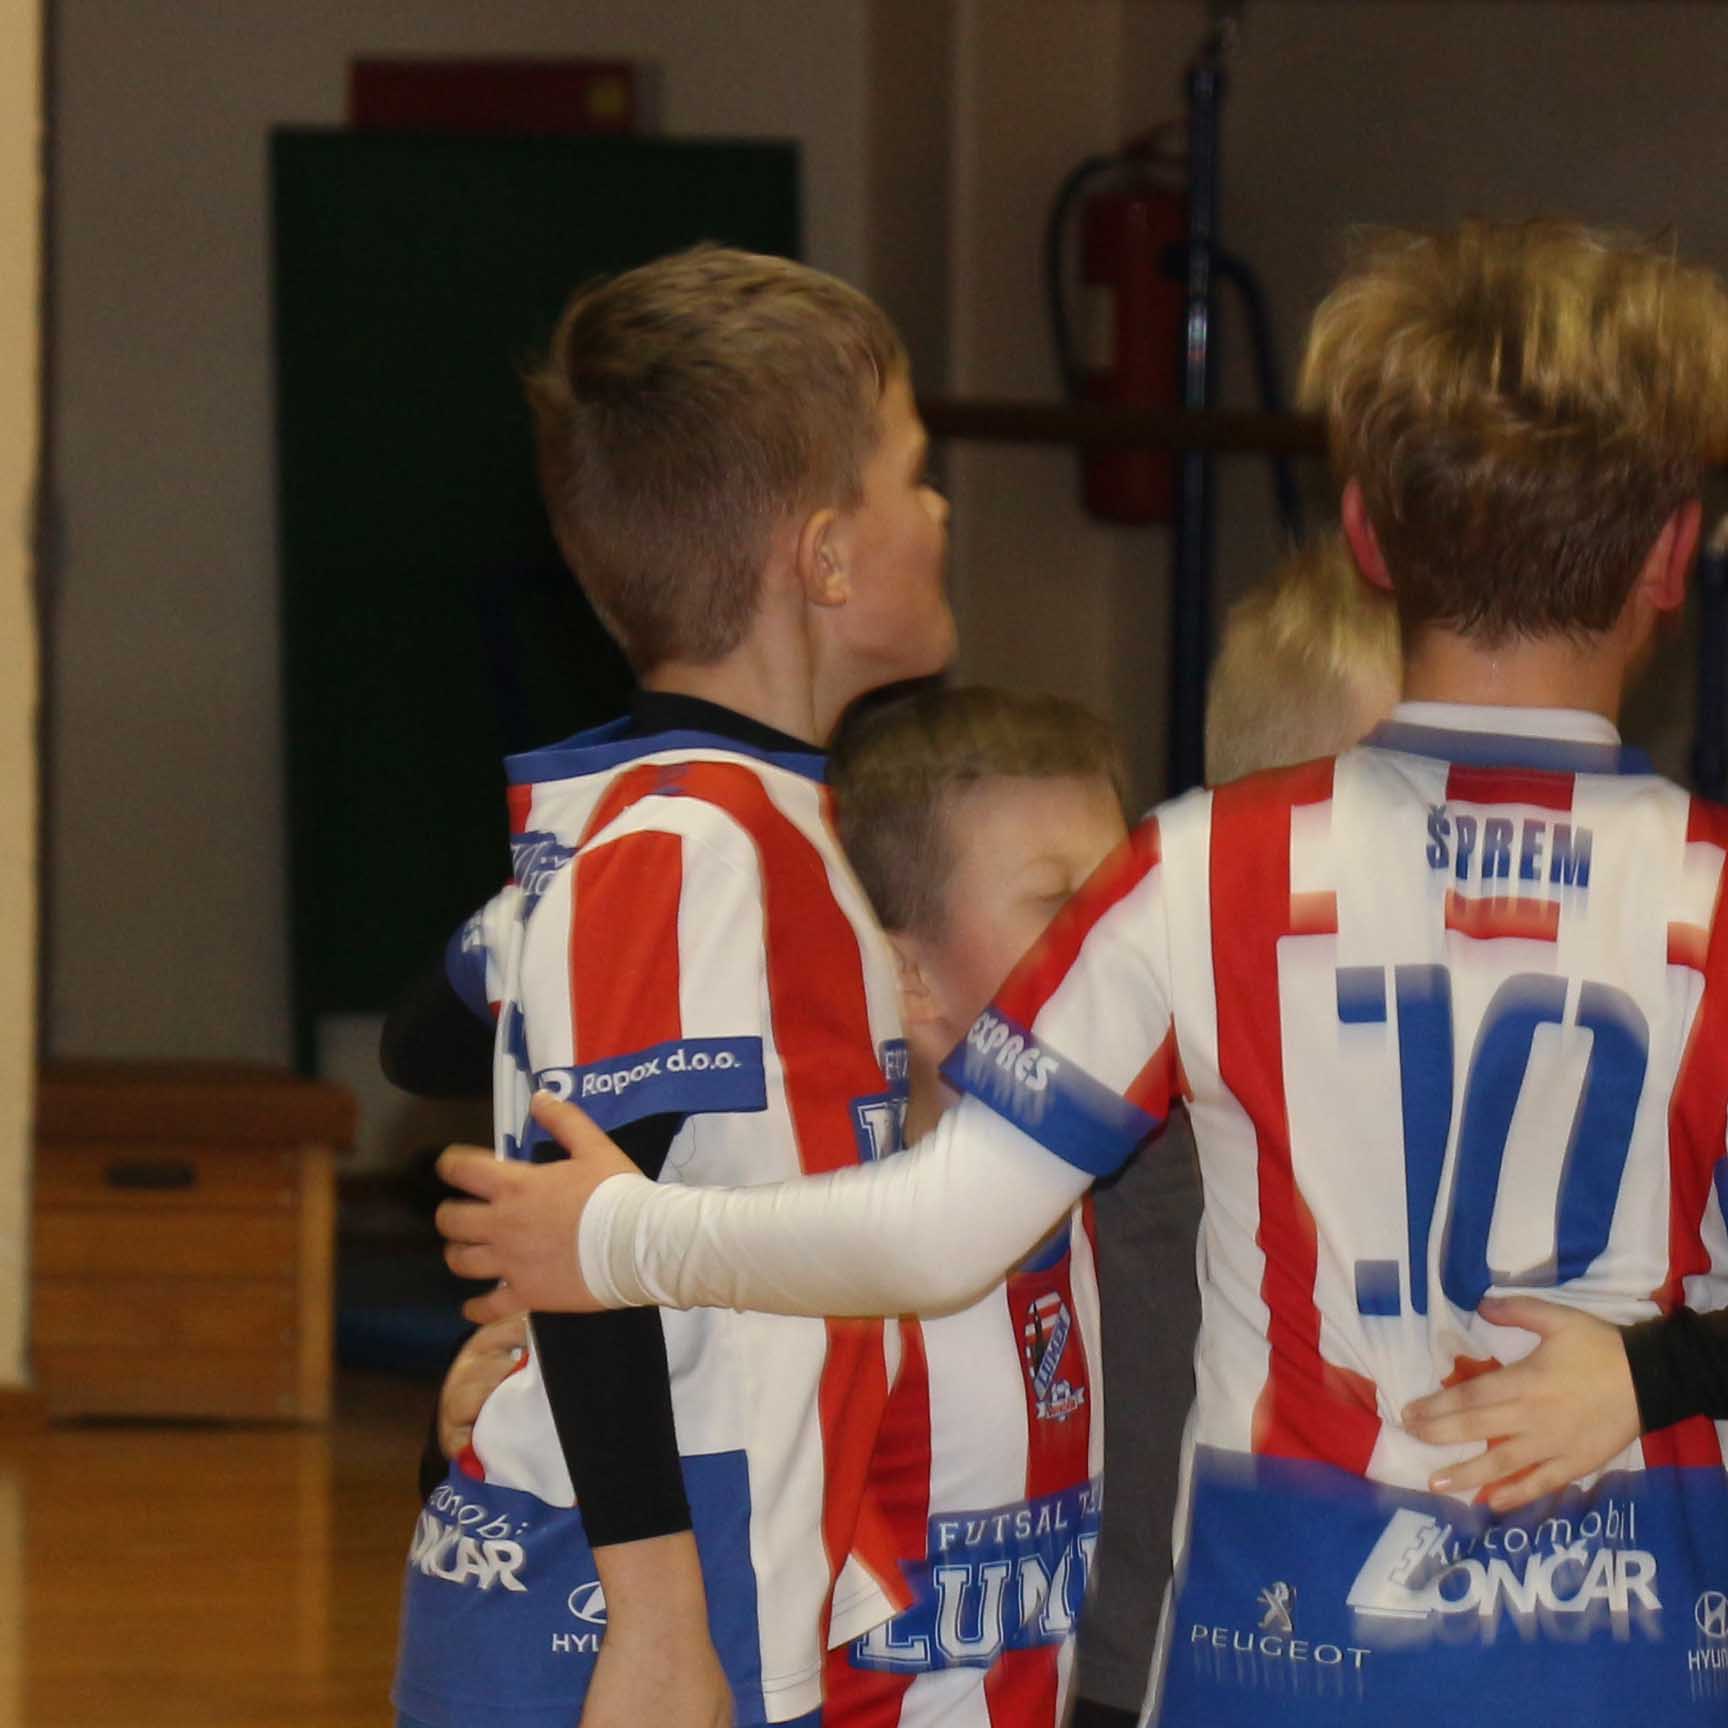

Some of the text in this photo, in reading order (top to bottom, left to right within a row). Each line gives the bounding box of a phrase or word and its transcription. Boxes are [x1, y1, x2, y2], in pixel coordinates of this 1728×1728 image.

[1426, 804, 1593, 888] ŠPREM
[581, 1048, 742, 1098] Ropox d.o.o.
[1335, 962, 1650, 1316] 10
[938, 1501, 1069, 1551] FUTSAL
[1191, 1624, 1372, 1669] PEUGEOT
